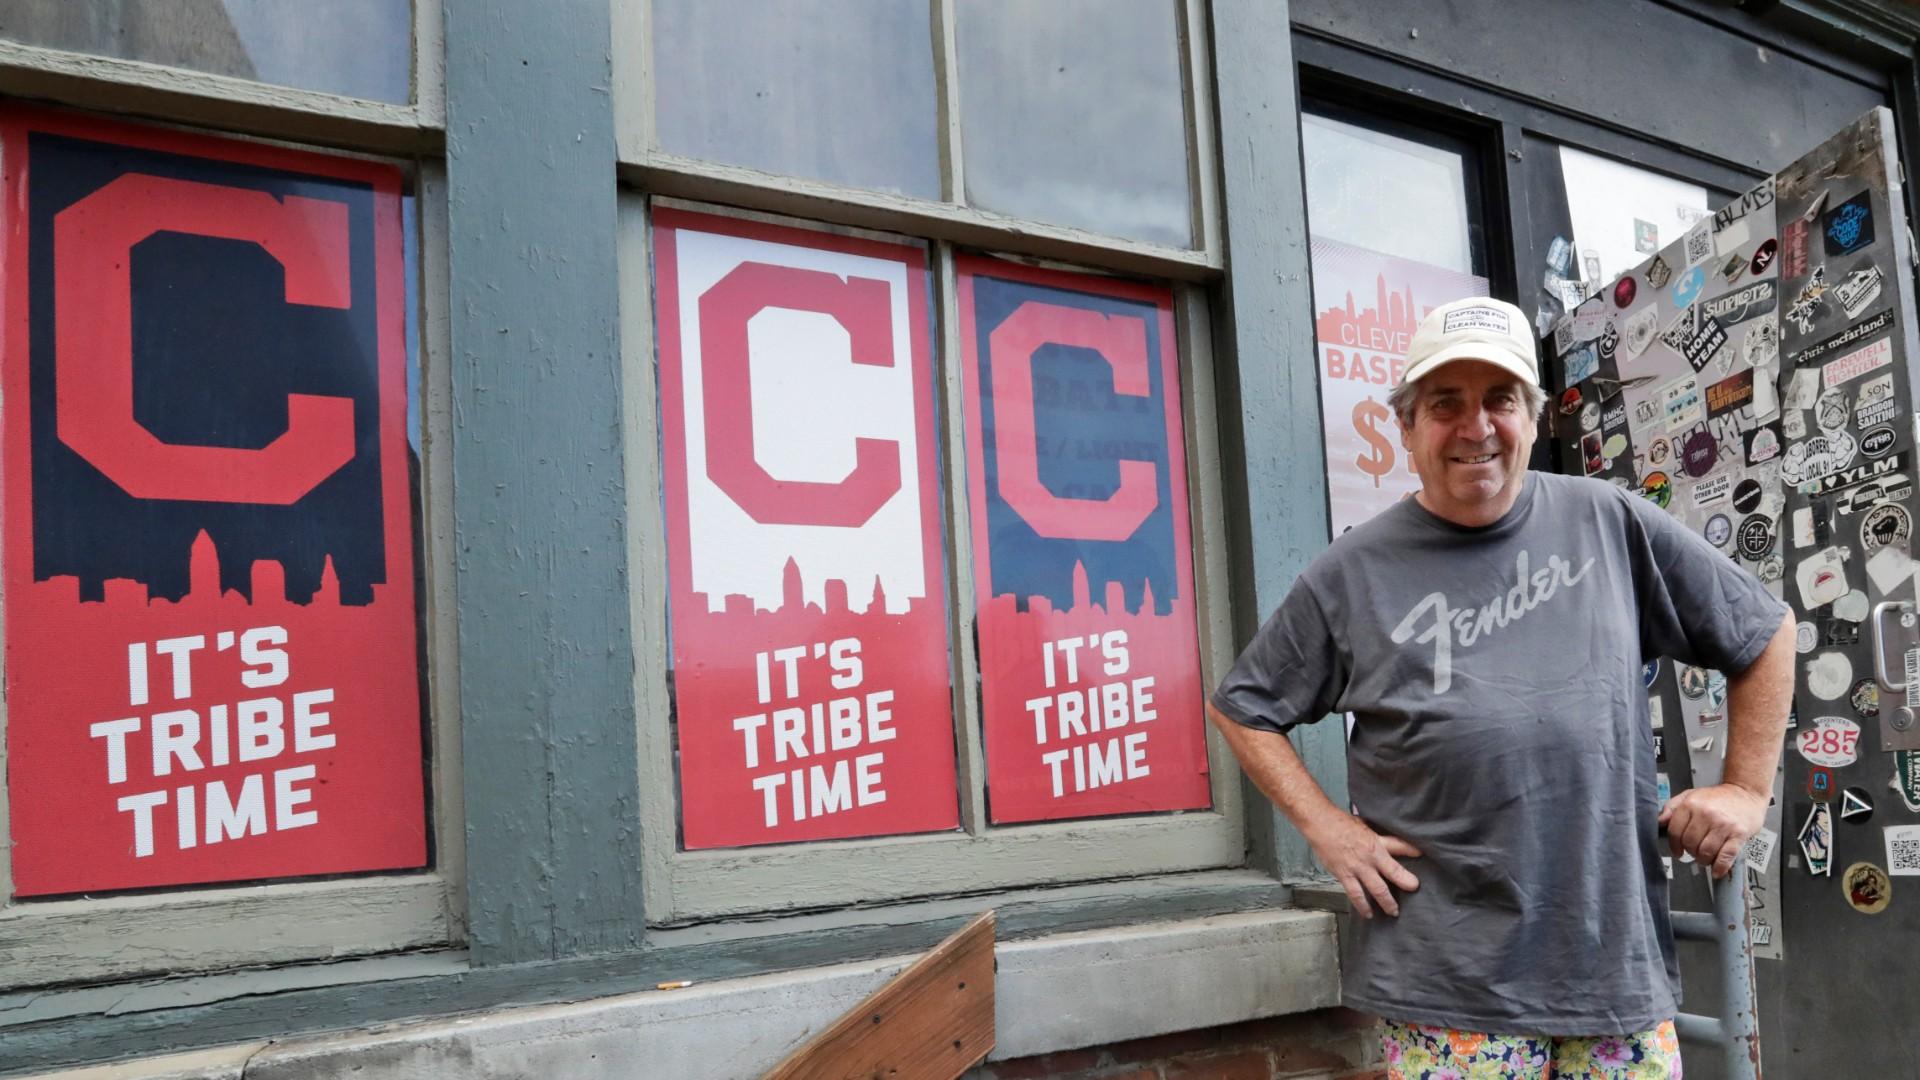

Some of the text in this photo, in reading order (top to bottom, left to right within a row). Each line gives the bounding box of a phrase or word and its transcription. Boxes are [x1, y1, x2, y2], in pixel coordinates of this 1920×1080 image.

[54, 172, 356, 505] C
[1341, 322, 1414, 354] CLEVE
[1447, 321, 1507, 331] CLEAN WATER
[1686, 320, 1718, 359] HOME
[1798, 345, 1826, 362] chris
[1828, 313, 1885, 350] mcfarland
[1326, 347, 1405, 388] BASE
[1693, 332, 1724, 367] TEAM
[1826, 340, 1887, 374] FAREWELL
[698, 260, 902, 528] C
[1857, 398, 1895, 420] BRANDON
[990, 300, 1158, 541] C
[1857, 407, 1896, 430] SANTINI
[1805, 438, 1831, 461] LABORERS
[1806, 463, 1824, 481] LOCAL
[1841, 455, 1899, 483] YLM
[1694, 482, 1730, 500] OTHER DOOR
[1695, 475, 1728, 492] PLEASE USE
[1390, 550, 1596, 695] Fender
[129, 625, 290, 705] IT'S
[755, 637, 863, 704] IT'S
[1043, 629, 1129, 688] IT'S
[733, 690, 897, 769] TRIBE
[1026, 676, 1158, 745] TRIBE
[90, 688, 337, 784] TRIBE
[1802, 729, 1858, 755] 285
[1042, 733, 1151, 799] TIME
[117, 764, 319, 858] TIME
[752, 753, 887, 828] TIME
